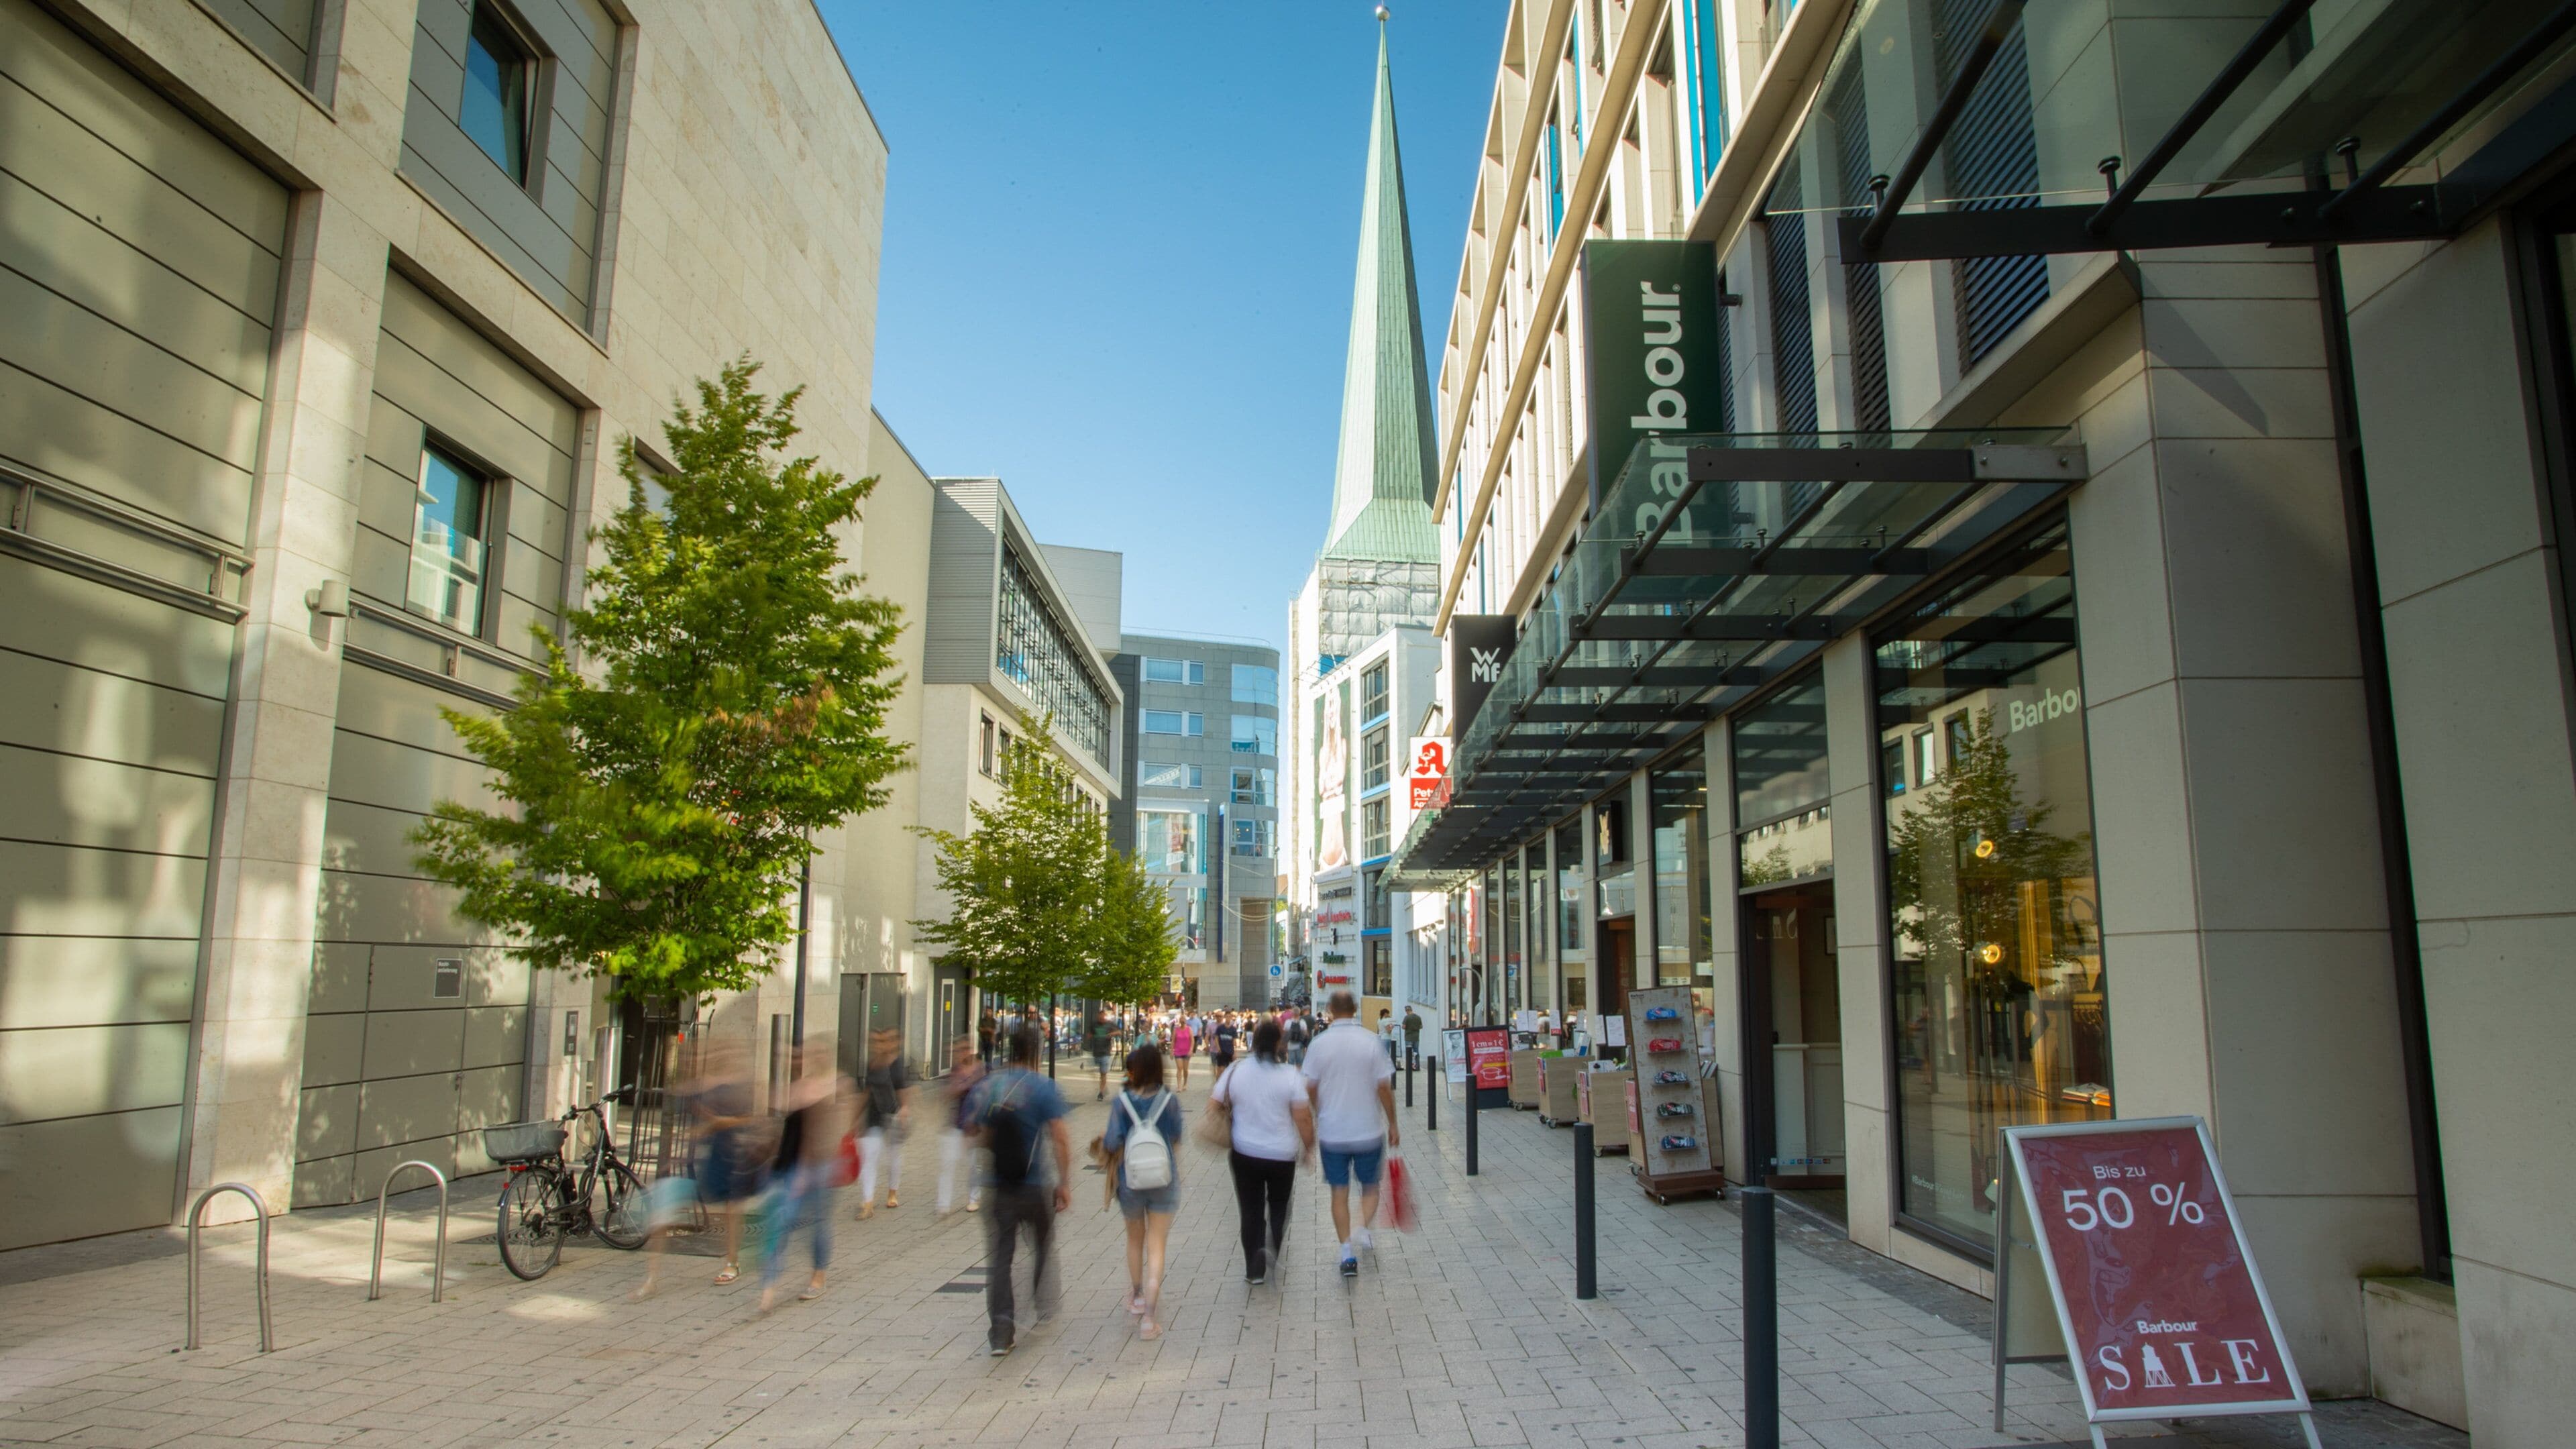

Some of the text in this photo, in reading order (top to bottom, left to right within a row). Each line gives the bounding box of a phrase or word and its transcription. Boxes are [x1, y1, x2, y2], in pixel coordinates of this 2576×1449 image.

[1470, 647, 1501, 682] WMF
[2092, 1165, 2147, 1179] Bis zu
[2063, 1181, 2204, 1231] 50 %
[2137, 1320, 2198, 1334] Barbour
[2098, 1338, 2271, 1391] SALE
